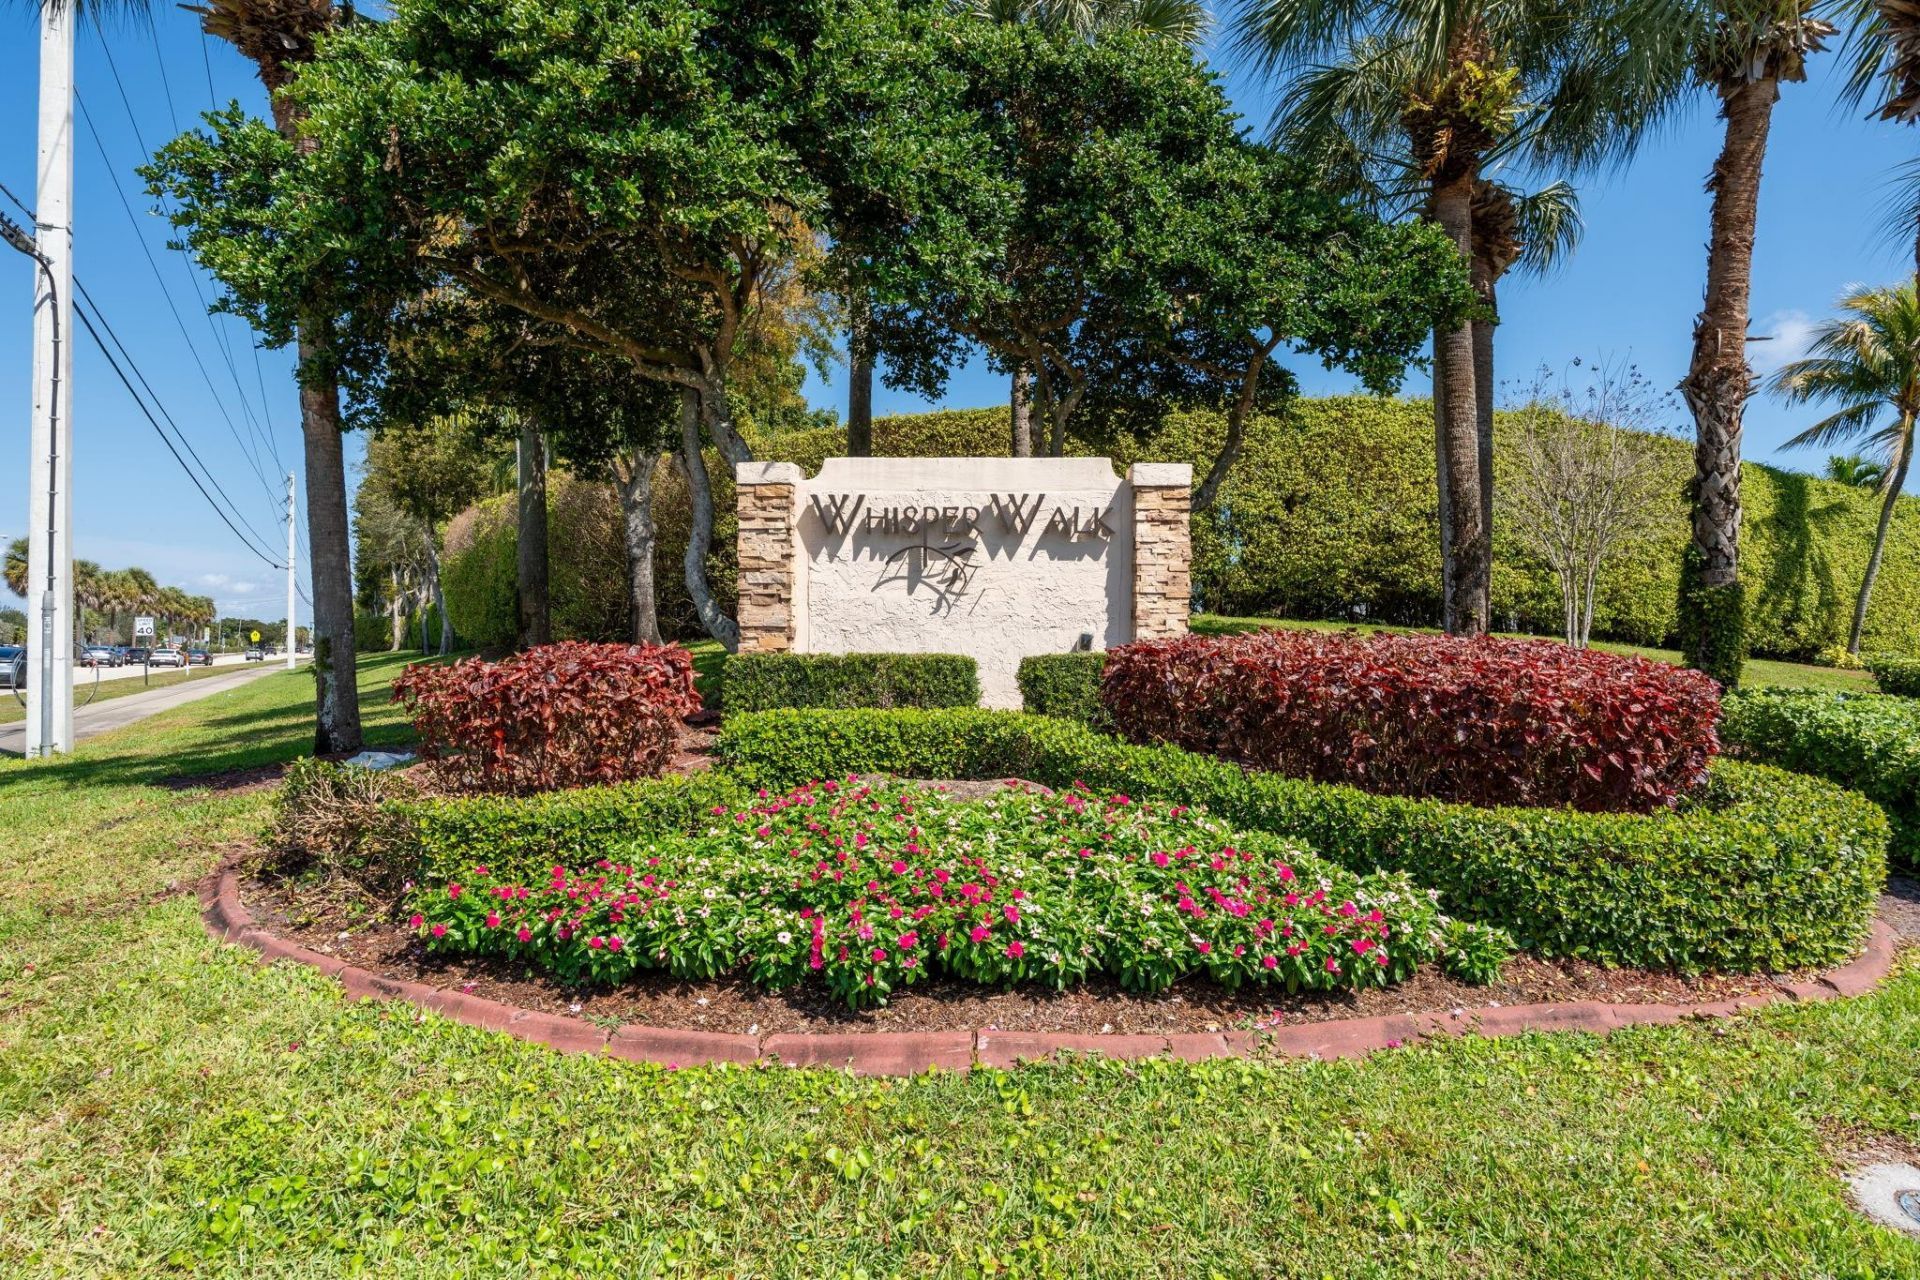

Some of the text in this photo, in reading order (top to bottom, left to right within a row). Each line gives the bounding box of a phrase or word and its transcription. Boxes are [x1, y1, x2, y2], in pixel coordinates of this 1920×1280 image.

[810, 493, 1115, 543] WHISPER WALK
[137, 626, 153, 635] 40
